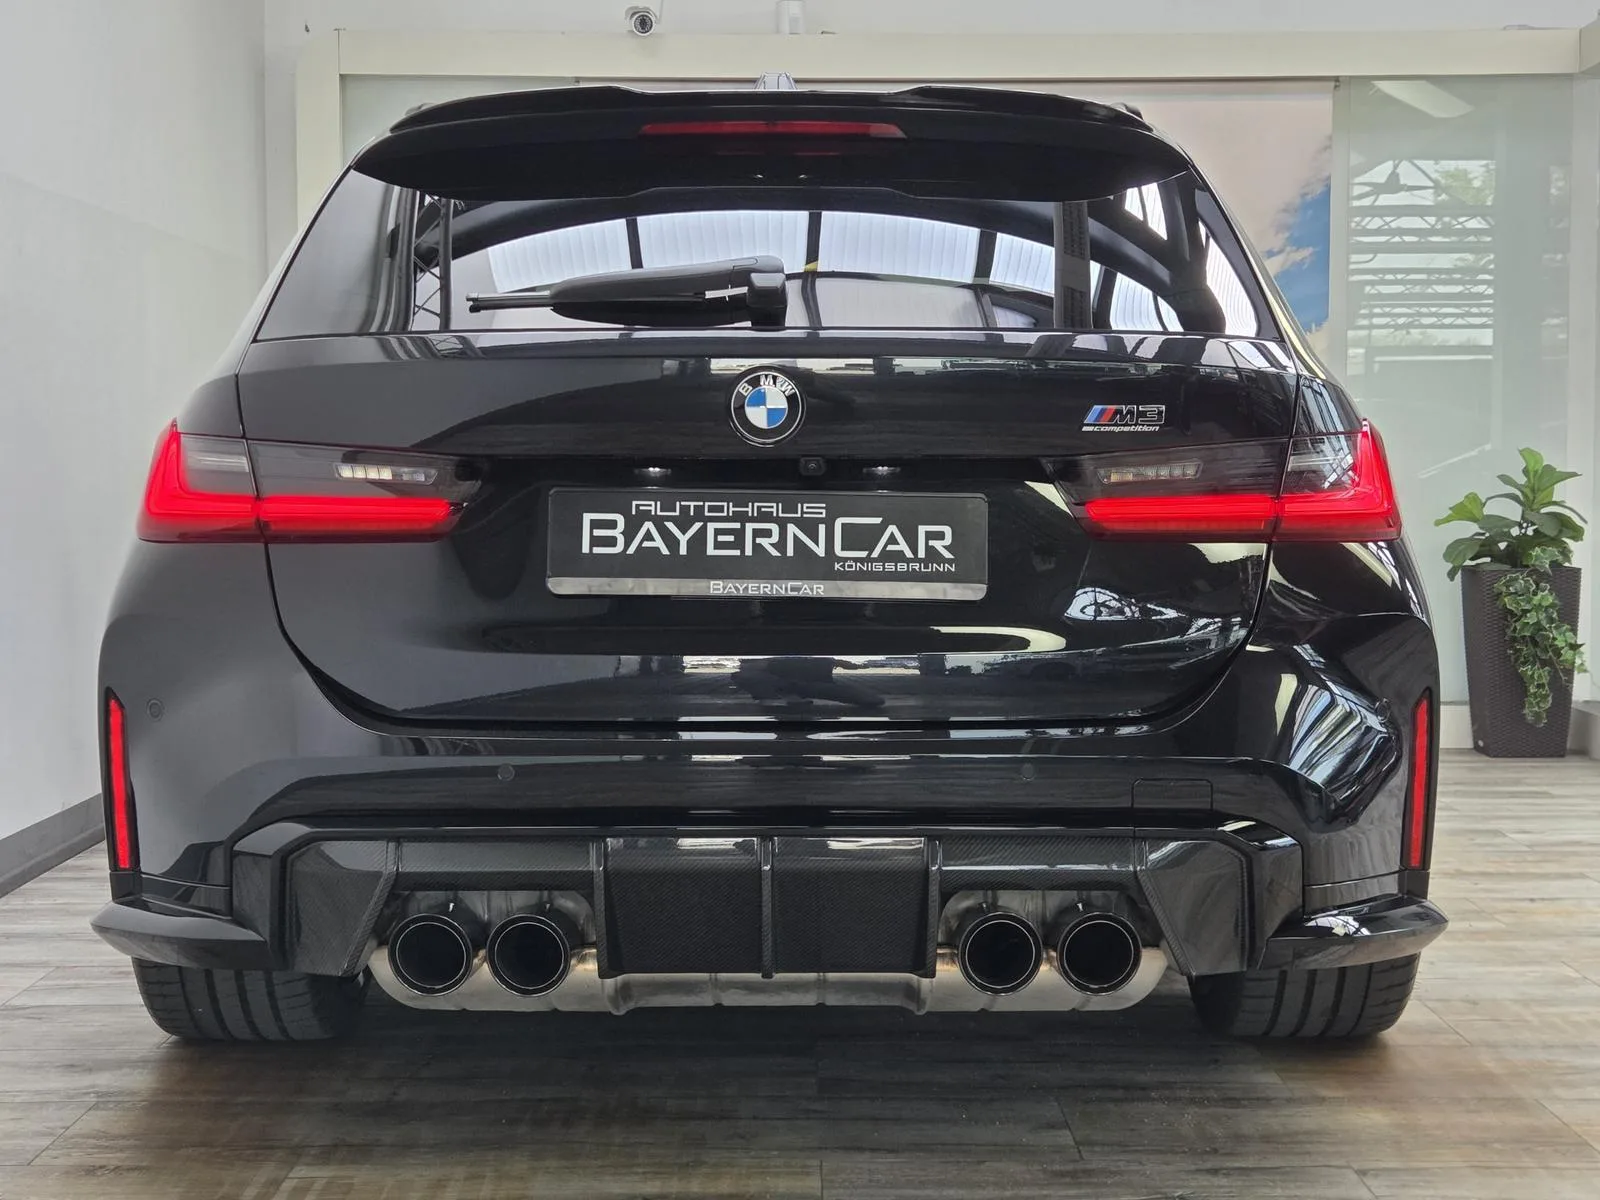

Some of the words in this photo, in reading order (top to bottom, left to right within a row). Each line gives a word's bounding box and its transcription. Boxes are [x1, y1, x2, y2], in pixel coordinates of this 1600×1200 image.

[739, 375, 795, 396] BMW
[1111, 405, 1166, 424] M3
[632, 501, 826, 517] AUTOHAUS
[834, 561, 956, 573] KÖNIGSBRUNN
